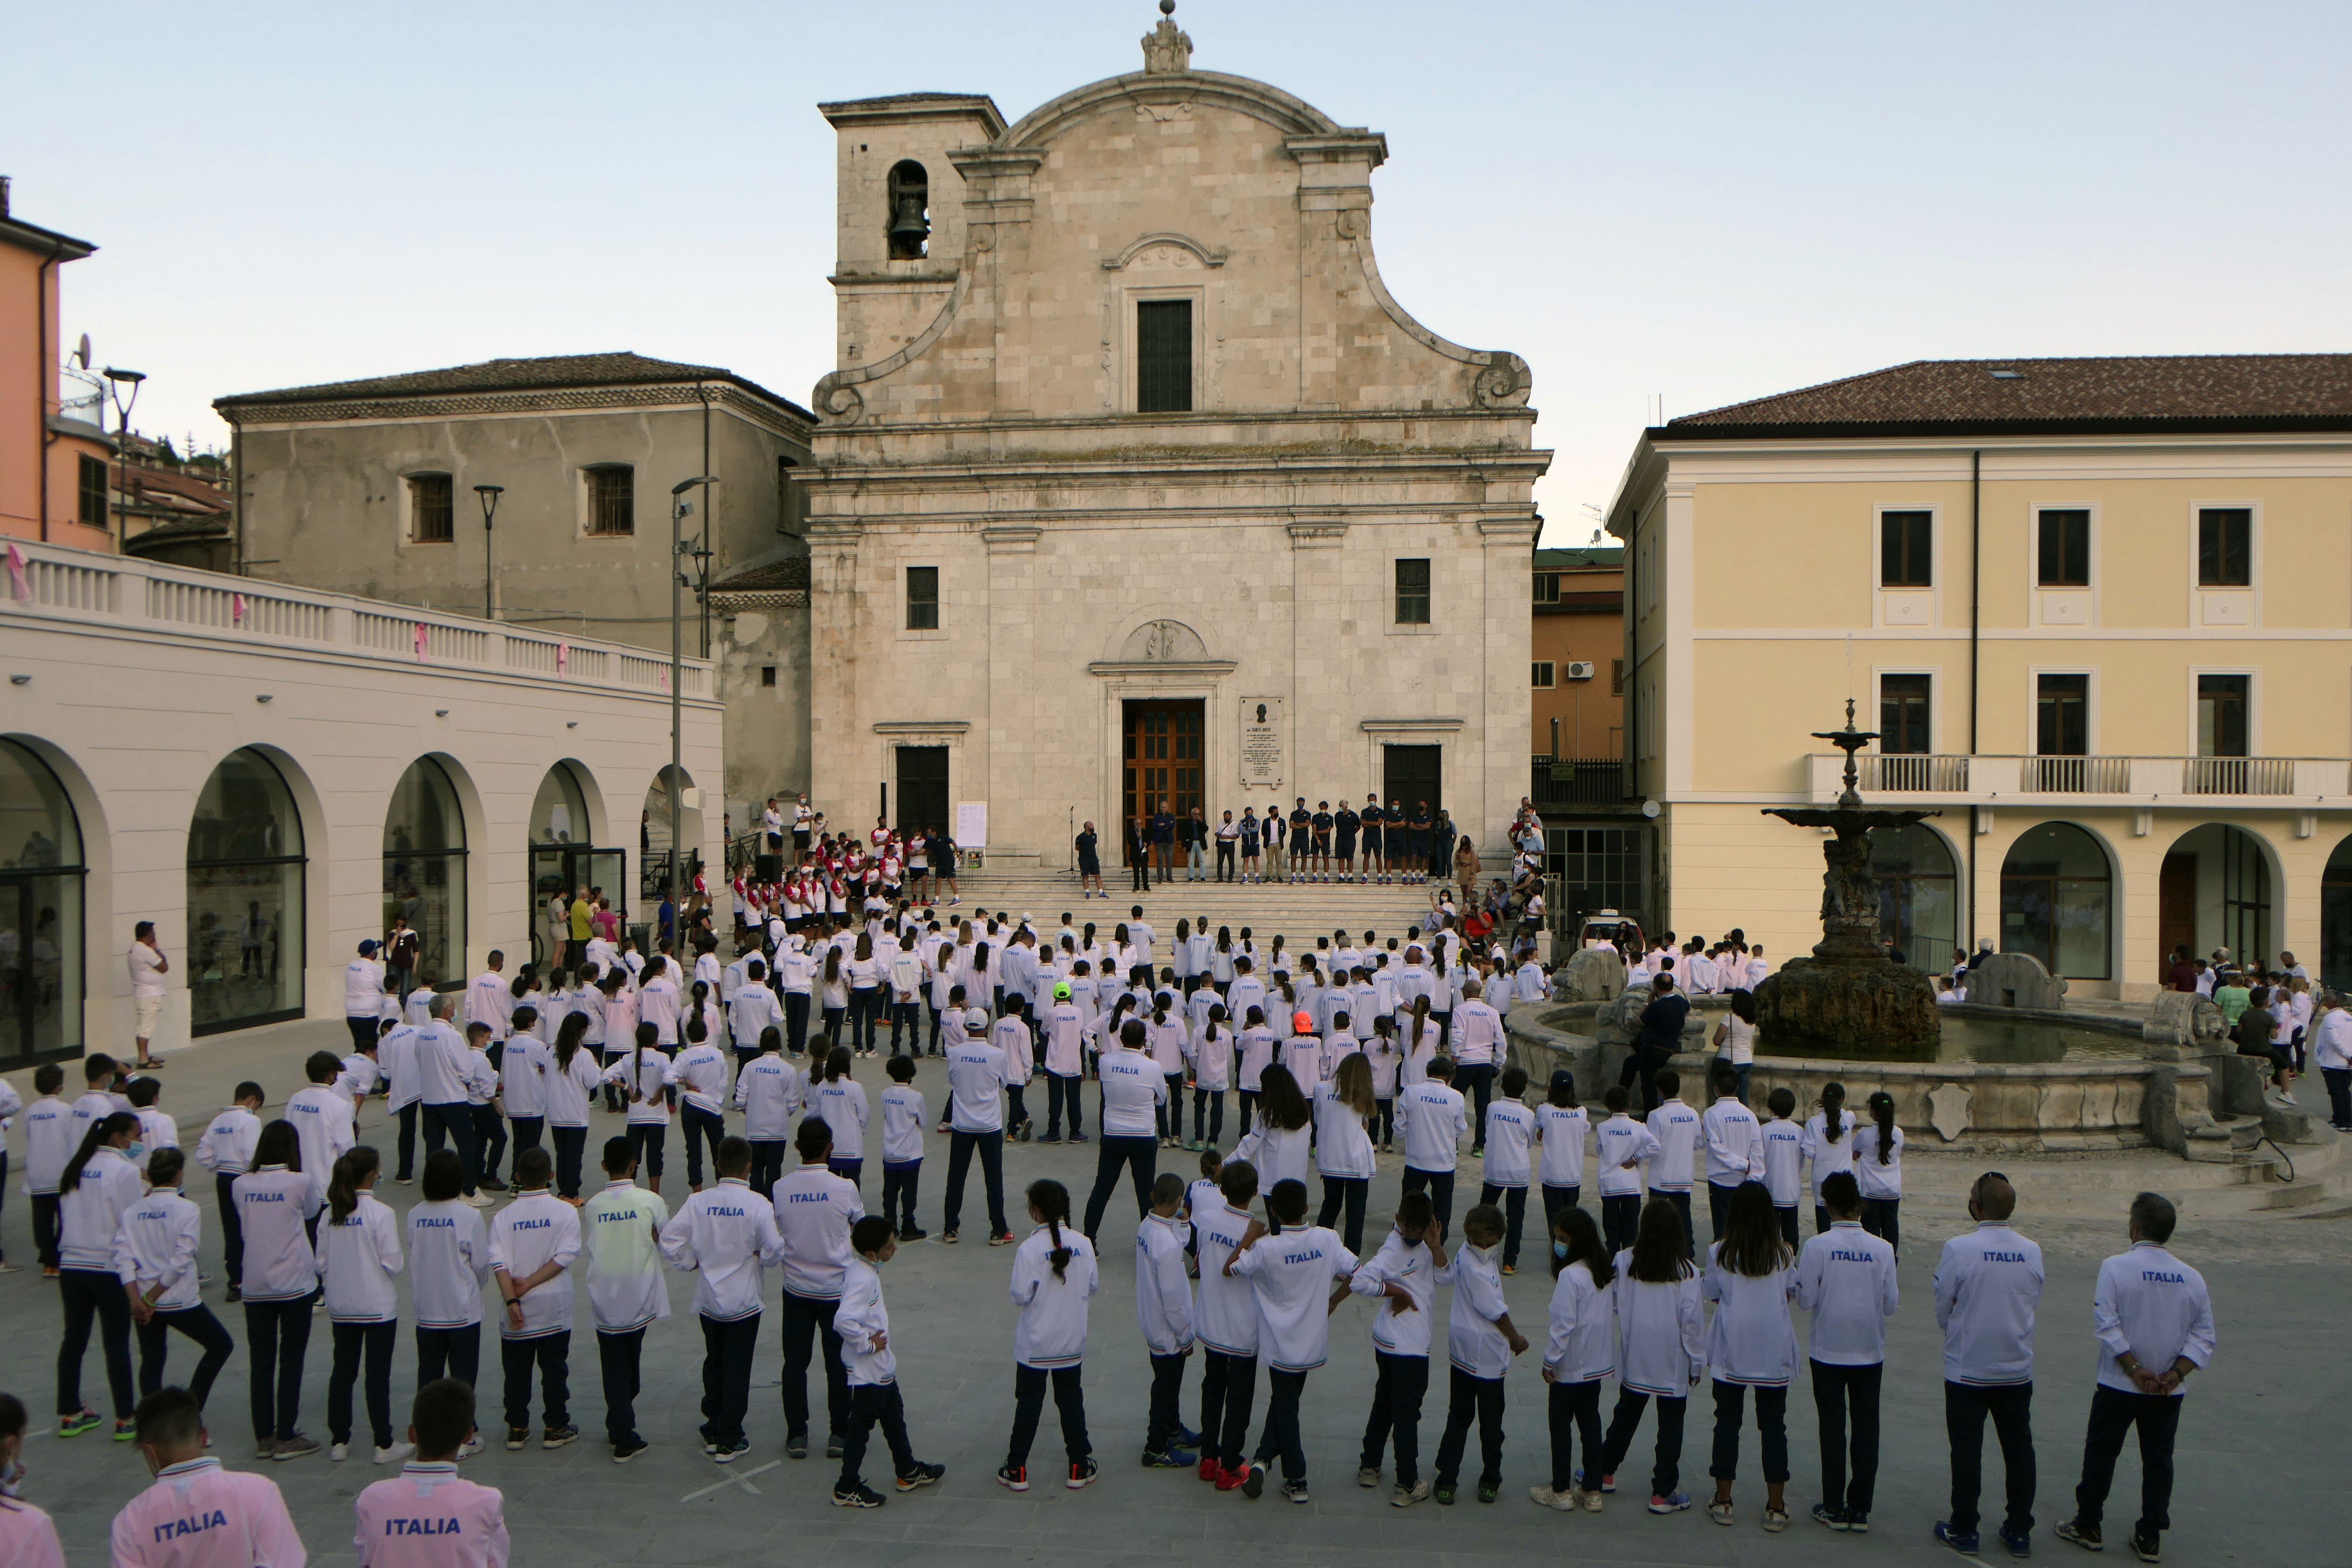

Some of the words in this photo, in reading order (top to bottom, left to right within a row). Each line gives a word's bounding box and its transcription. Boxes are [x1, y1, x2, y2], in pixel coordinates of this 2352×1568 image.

[390, 1028, 414, 1042] ITALIA
[690, 1056, 715, 1066] ITALIA
[1112, 1066, 1139, 1075] ITALIA
[1421, 1095, 1447, 1105] ITALIA
[293, 1105, 319, 1114] ITALIA
[1494, 1114, 1520, 1124] ITALIA
[245, 1192, 285, 1202] ITALIA
[790, 1191, 829, 1203] ITALIA
[138, 1211, 167, 1219] ITALIA
[598, 1209, 637, 1222] ITALIA
[707, 1206, 745, 1216] ITALIA
[417, 1217, 455, 1227] ITALIA
[513, 1218, 552, 1231] ITALIA
[1285, 1249, 1323, 1263] ITALIA
[1832, 1250, 1873, 1262] ITALIA
[1984, 1250, 2025, 1262] ITALIA
[2143, 1271, 2185, 1283] ITALIA
[155, 1510, 227, 1542] ITALIA
[386, 1518, 461, 1535] ITALIA
